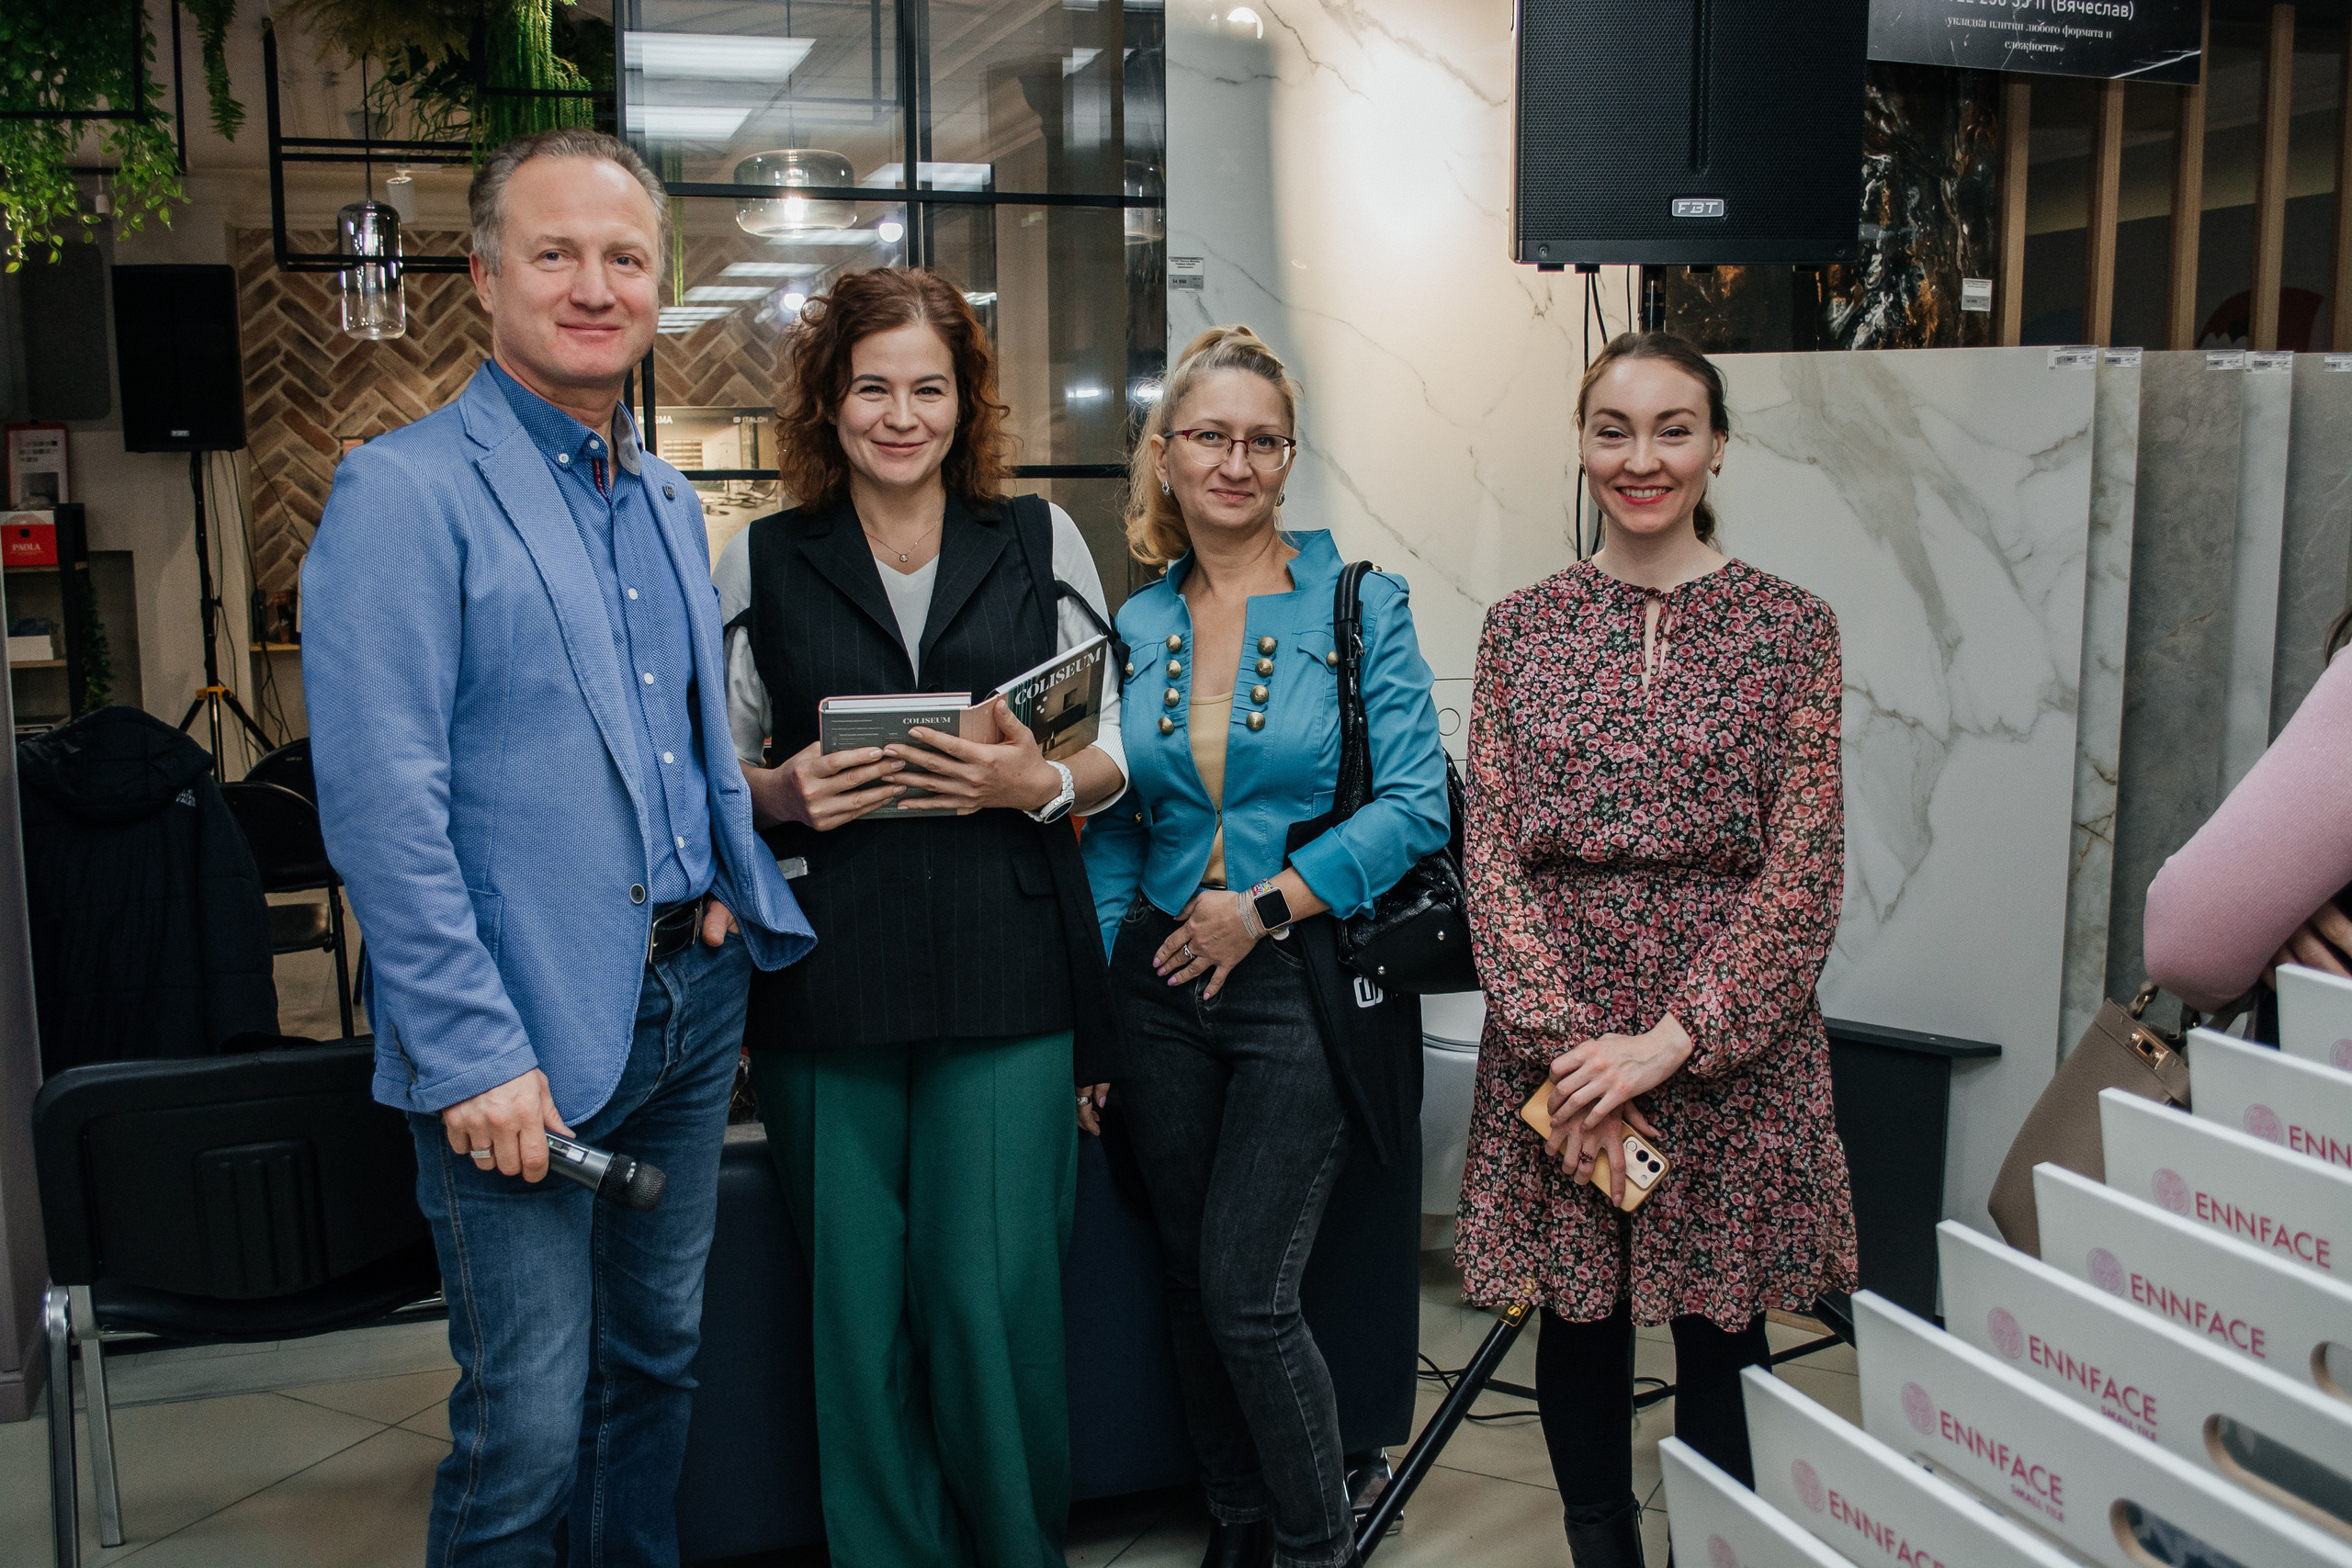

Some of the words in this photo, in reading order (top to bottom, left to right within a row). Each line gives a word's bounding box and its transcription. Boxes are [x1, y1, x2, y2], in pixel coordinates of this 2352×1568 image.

[1947, 17, 1987, 28] укладка
[1989, 20, 2024, 31] плитки
[2025, 22, 2061, 35] любого
[2062, 25, 2103, 39] формата
[2105, 29, 2113, 39] и
[2051, 0, 2134, 21] (Вячеслав)
[1678, 201, 1718, 214] FBT
[12, 543, 41, 551] PAOLA
[1014, 647, 1102, 705] COLISEUM
[902, 716, 952, 725] COLISEUM
[2195, 1191, 2330, 1269] ENNFACE
[2130, 1272, 2266, 1359] ENNFACE
[2029, 1335, 2157, 1426] ENNFACE
[1939, 1409, 2064, 1506] ENNFACE
[1828, 1488, 1945, 1568] ENNFAC
